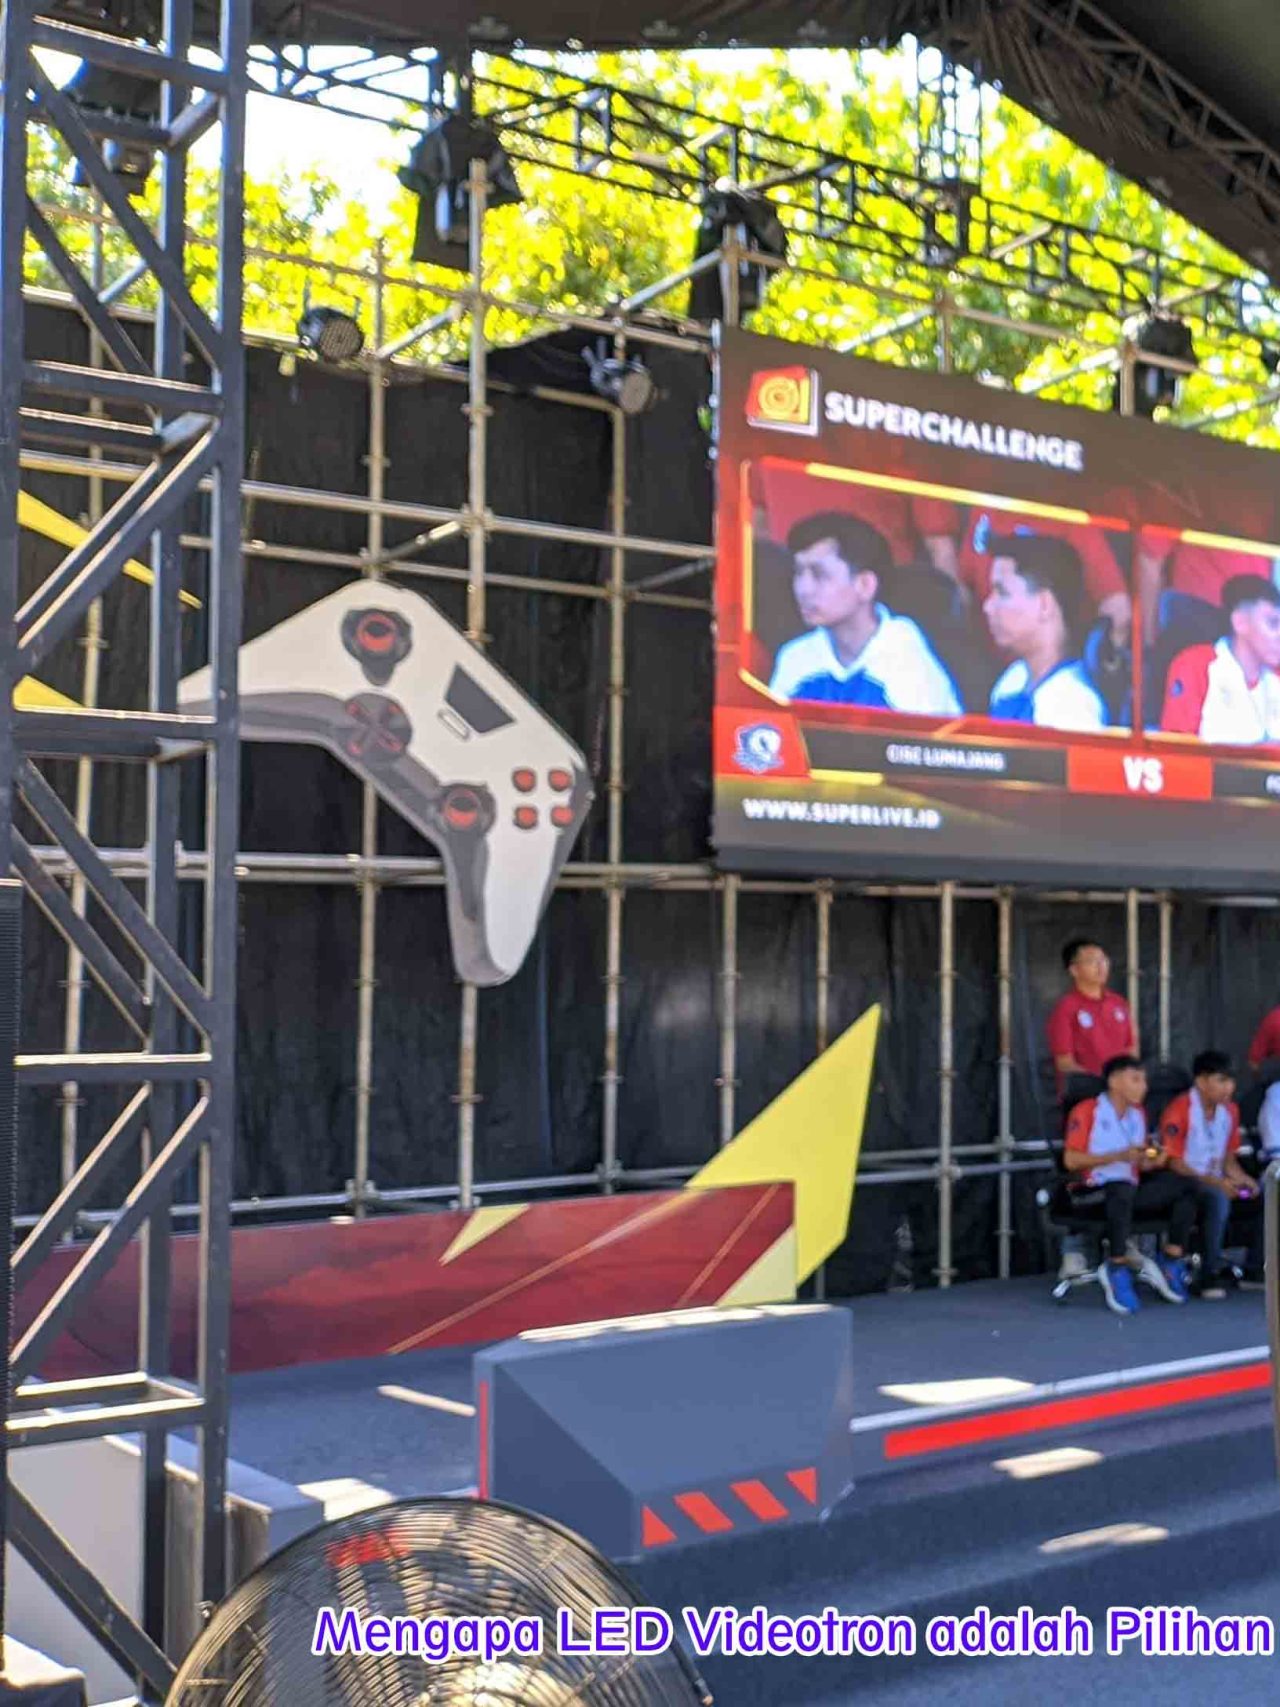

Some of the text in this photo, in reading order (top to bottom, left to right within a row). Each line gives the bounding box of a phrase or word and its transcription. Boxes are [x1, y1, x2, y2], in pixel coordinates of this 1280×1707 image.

[823, 391, 1084, 471] SUPERCHALLENGE
[1122, 756, 1164, 793] VS
[743, 798, 942, 829] WWW.SUPERLIVE.ID
